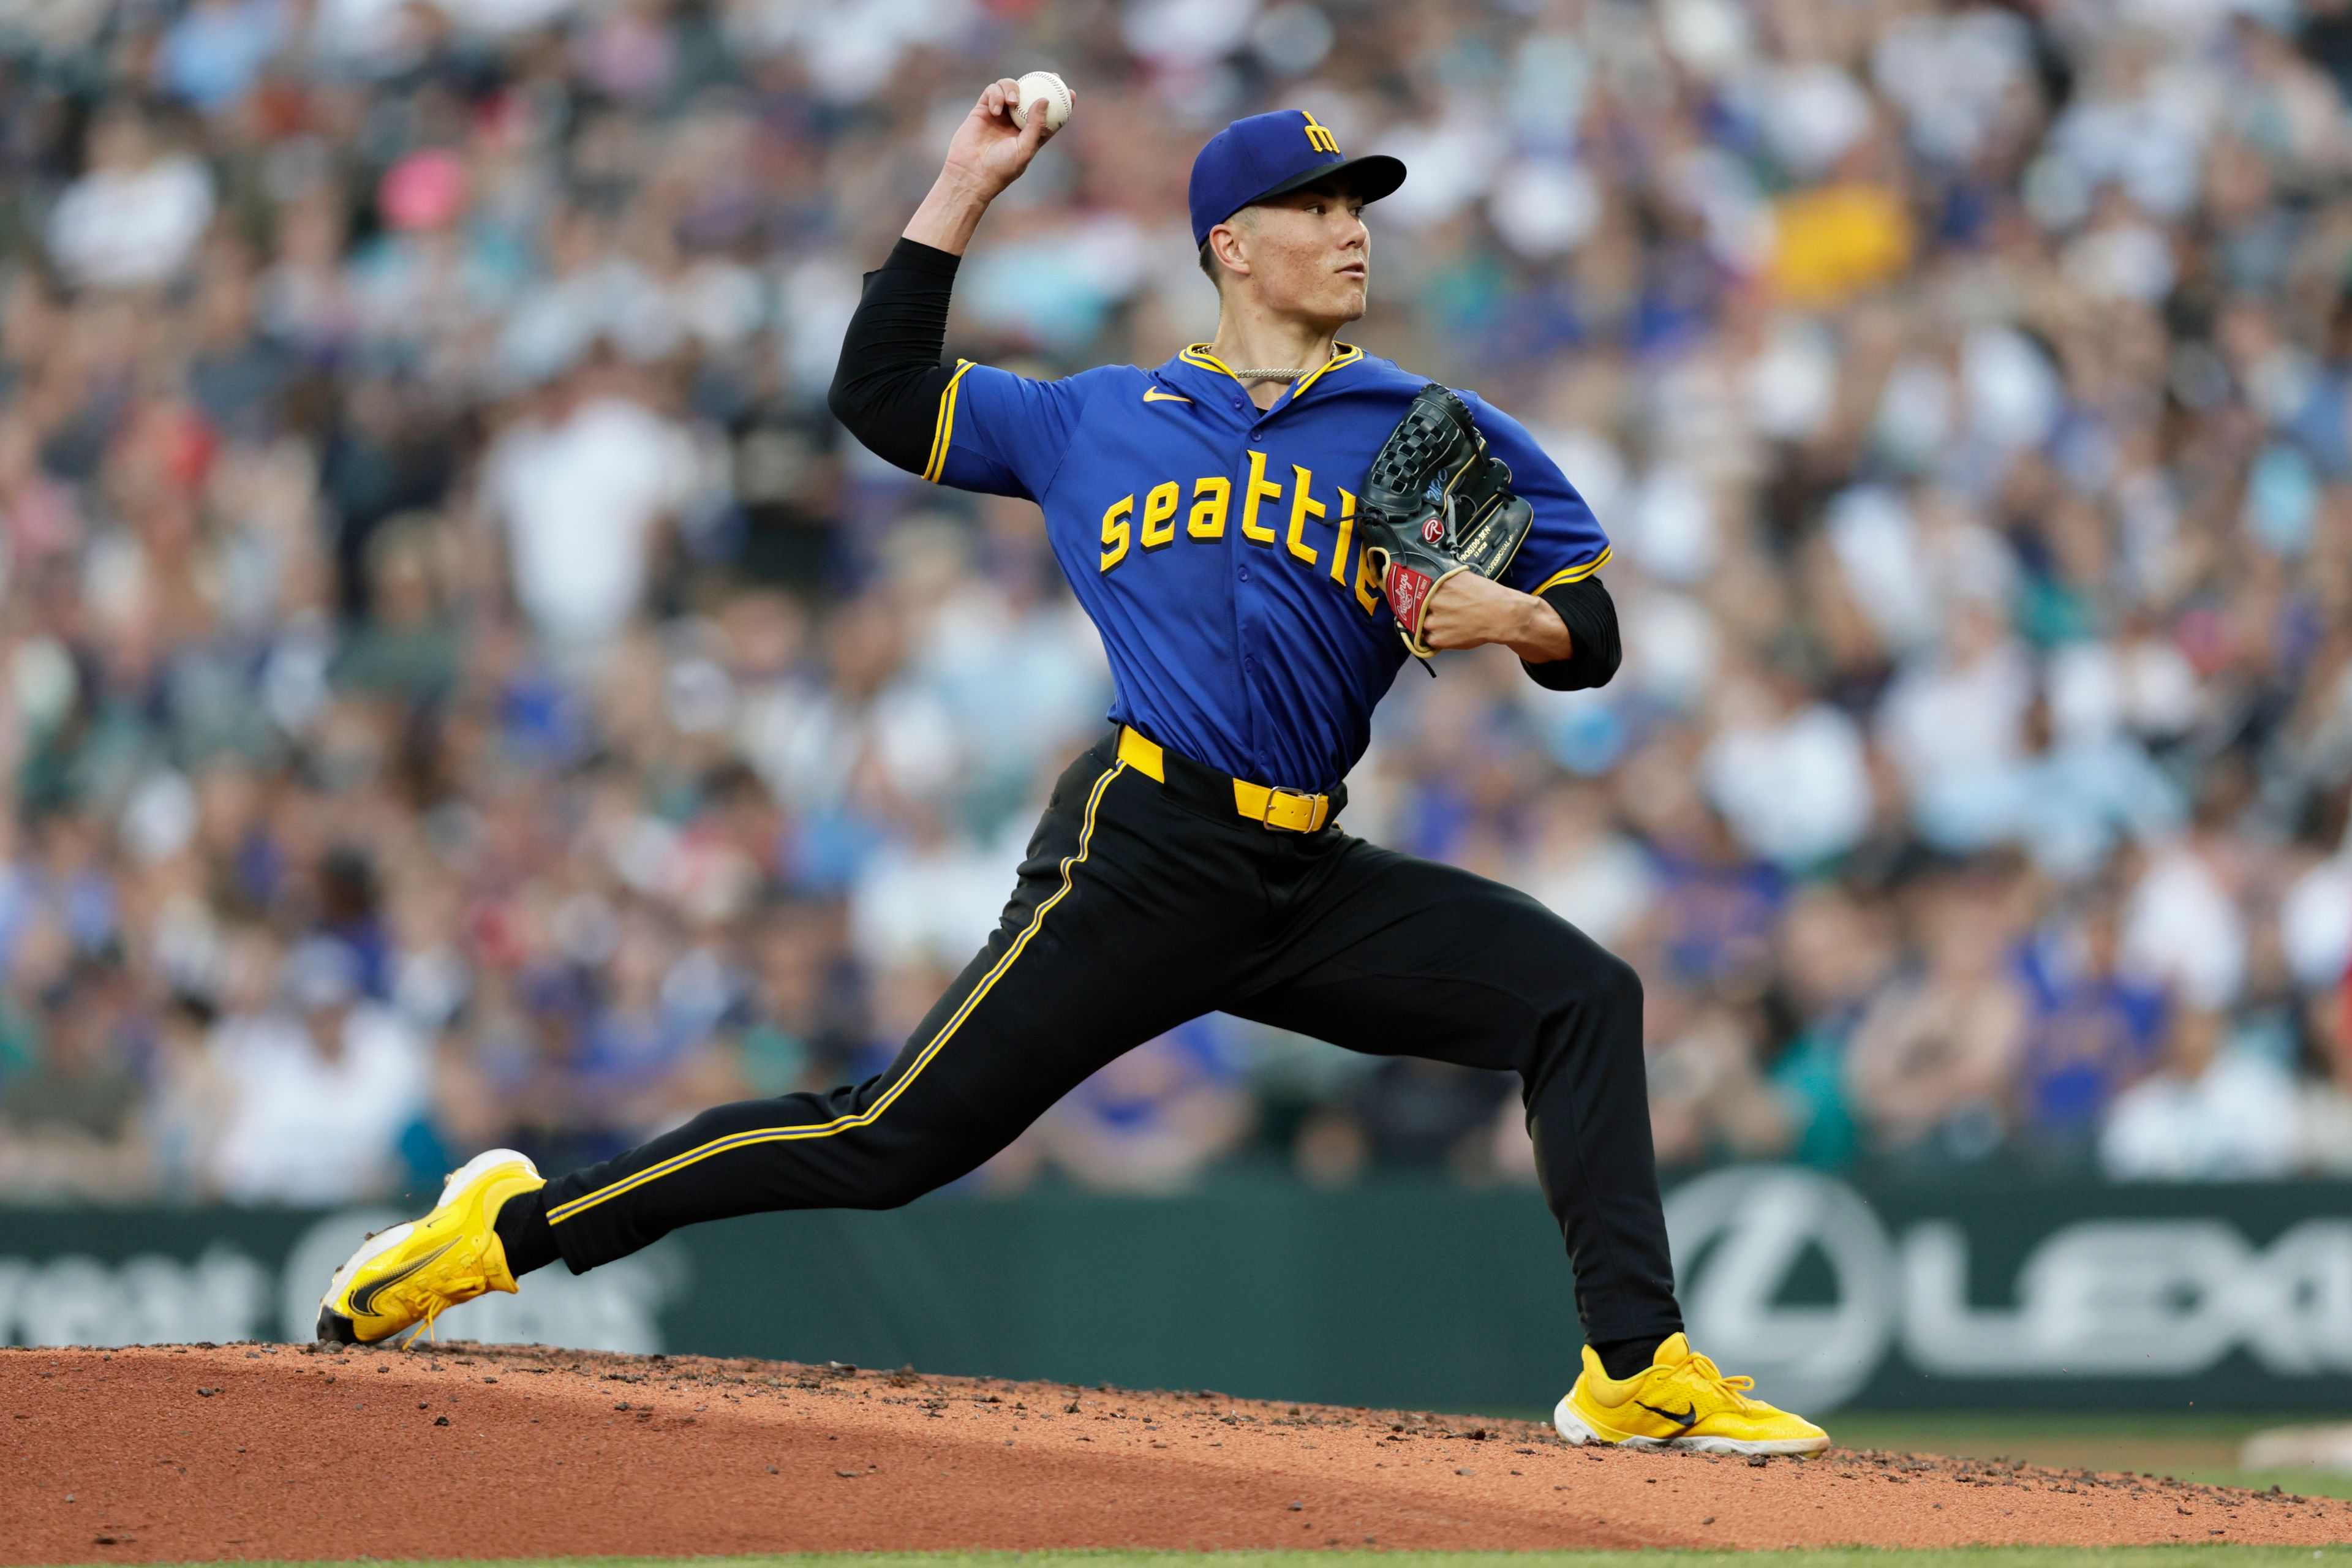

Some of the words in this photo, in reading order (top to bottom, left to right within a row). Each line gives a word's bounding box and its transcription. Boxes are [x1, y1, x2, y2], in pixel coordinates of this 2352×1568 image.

[1100, 450, 1380, 617] seattle
[1395, 573, 1413, 621] Rawlings
[1902, 1219, 2352, 1377] LEX
